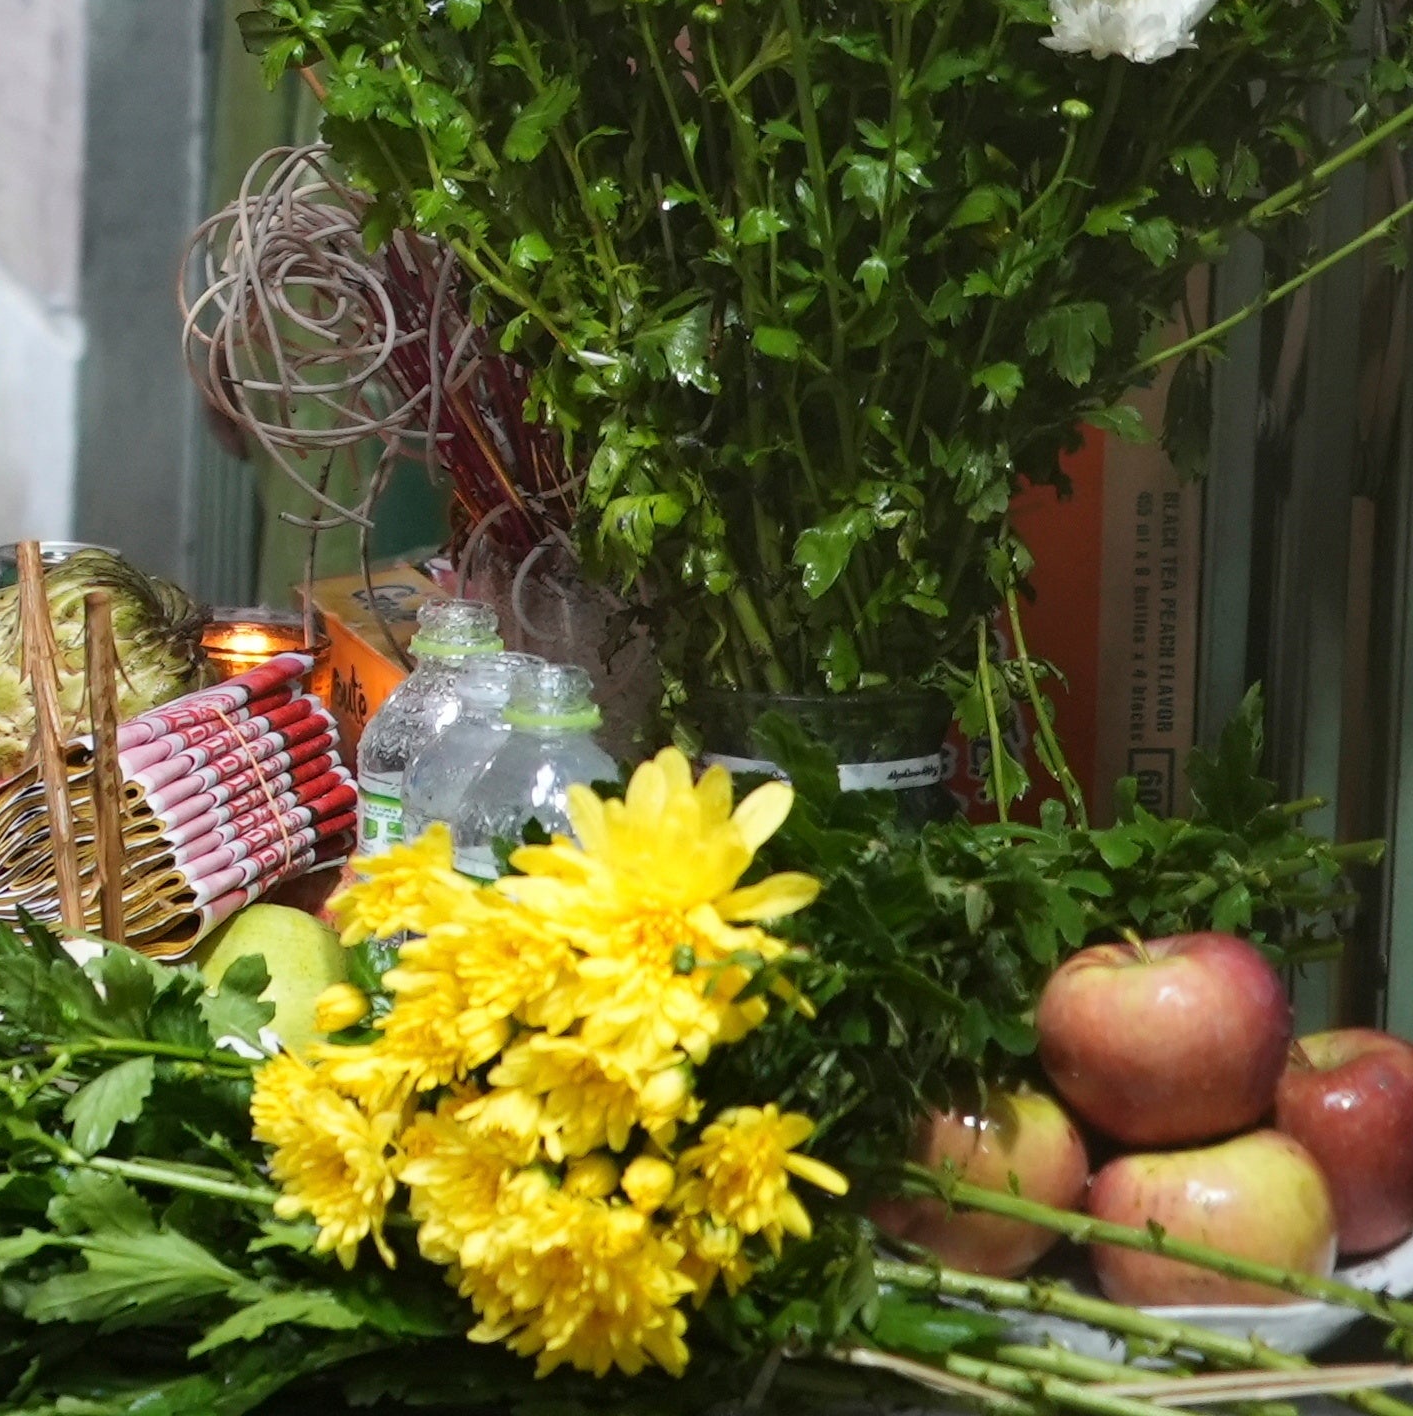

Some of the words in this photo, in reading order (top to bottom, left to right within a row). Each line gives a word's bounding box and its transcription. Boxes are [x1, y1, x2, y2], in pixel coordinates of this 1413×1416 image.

[1162, 491, 1180, 547] BLACK
[1160, 556, 1179, 591] TEA
[1132, 586, 1151, 644] bottles
[1158, 598, 1178, 659] PEACH
[1130, 686, 1148, 742] blocks
[1156, 664, 1175, 733] FLAVOR
[1135, 769, 1165, 817] 60
